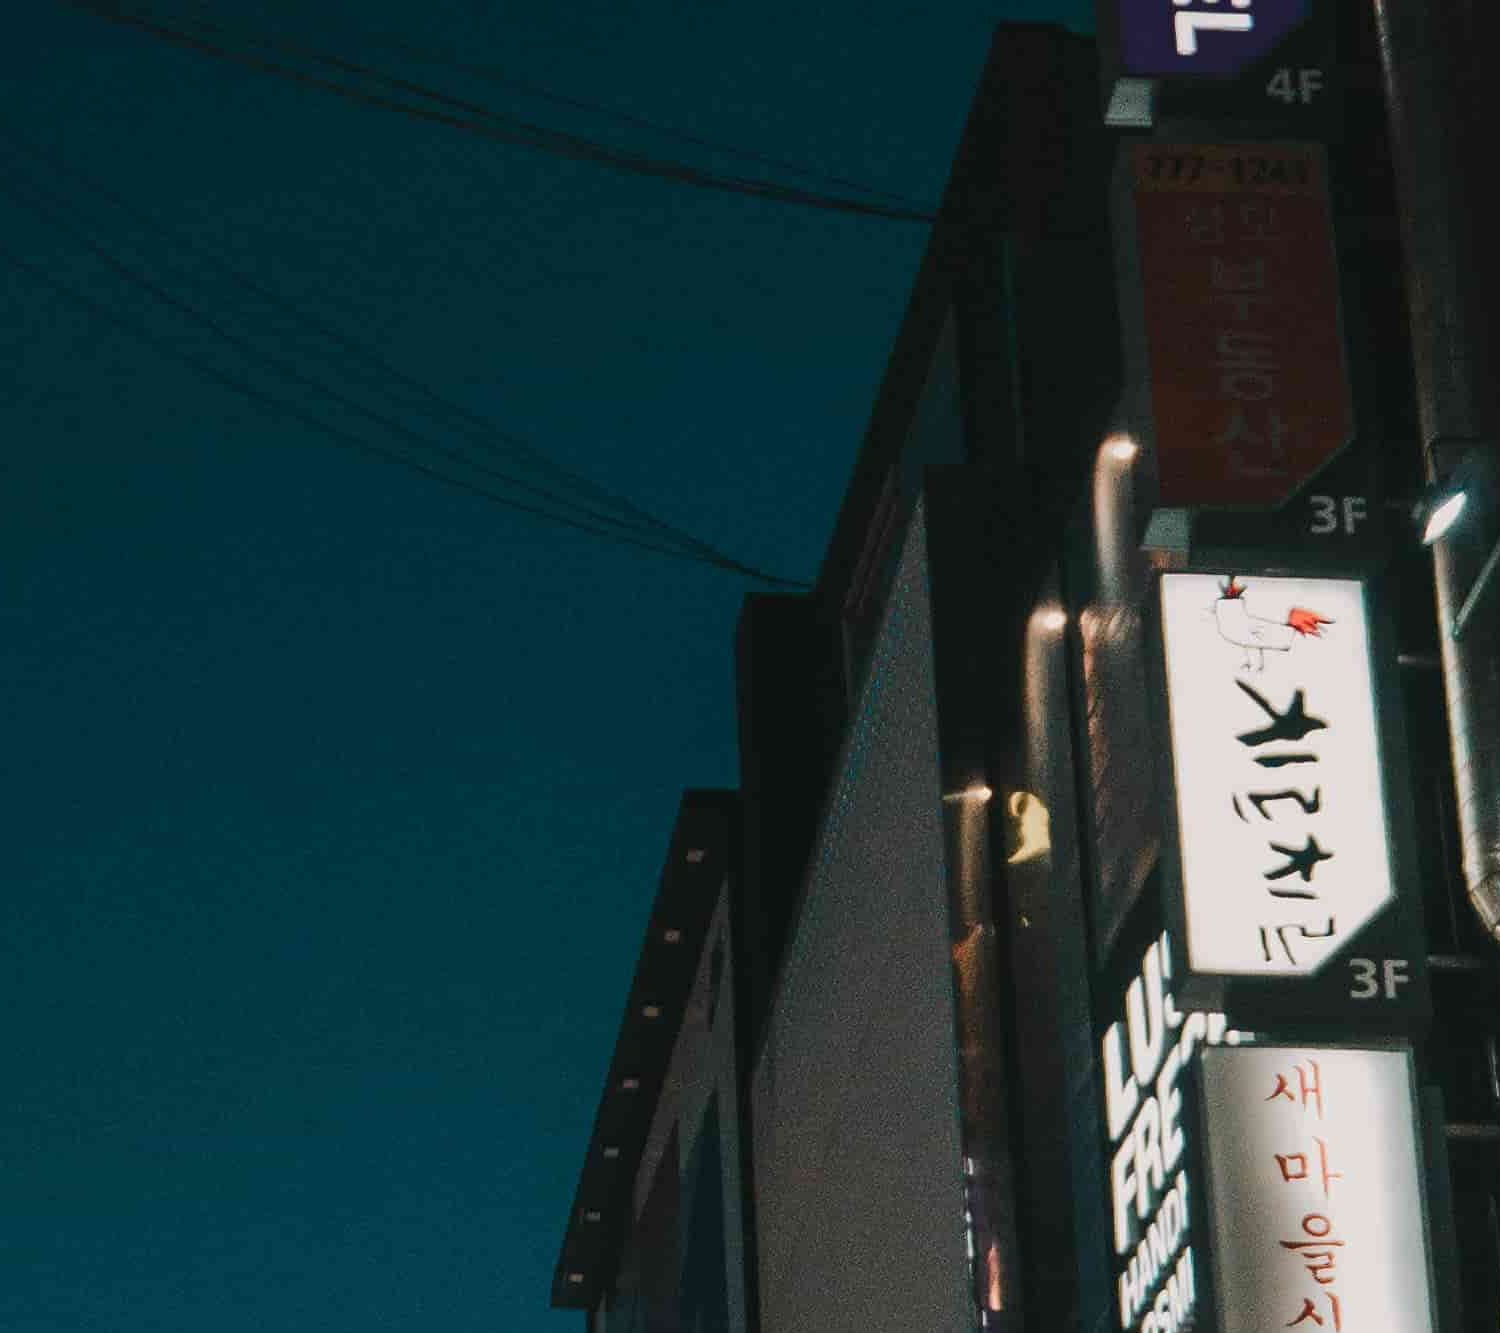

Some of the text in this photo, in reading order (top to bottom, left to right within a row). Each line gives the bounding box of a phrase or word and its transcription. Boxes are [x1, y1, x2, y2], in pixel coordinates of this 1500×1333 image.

[1266, 68, 1324, 104] 4F
[1311, 496, 1367, 534] 3F
[1349, 958, 1409, 1000] 3F
